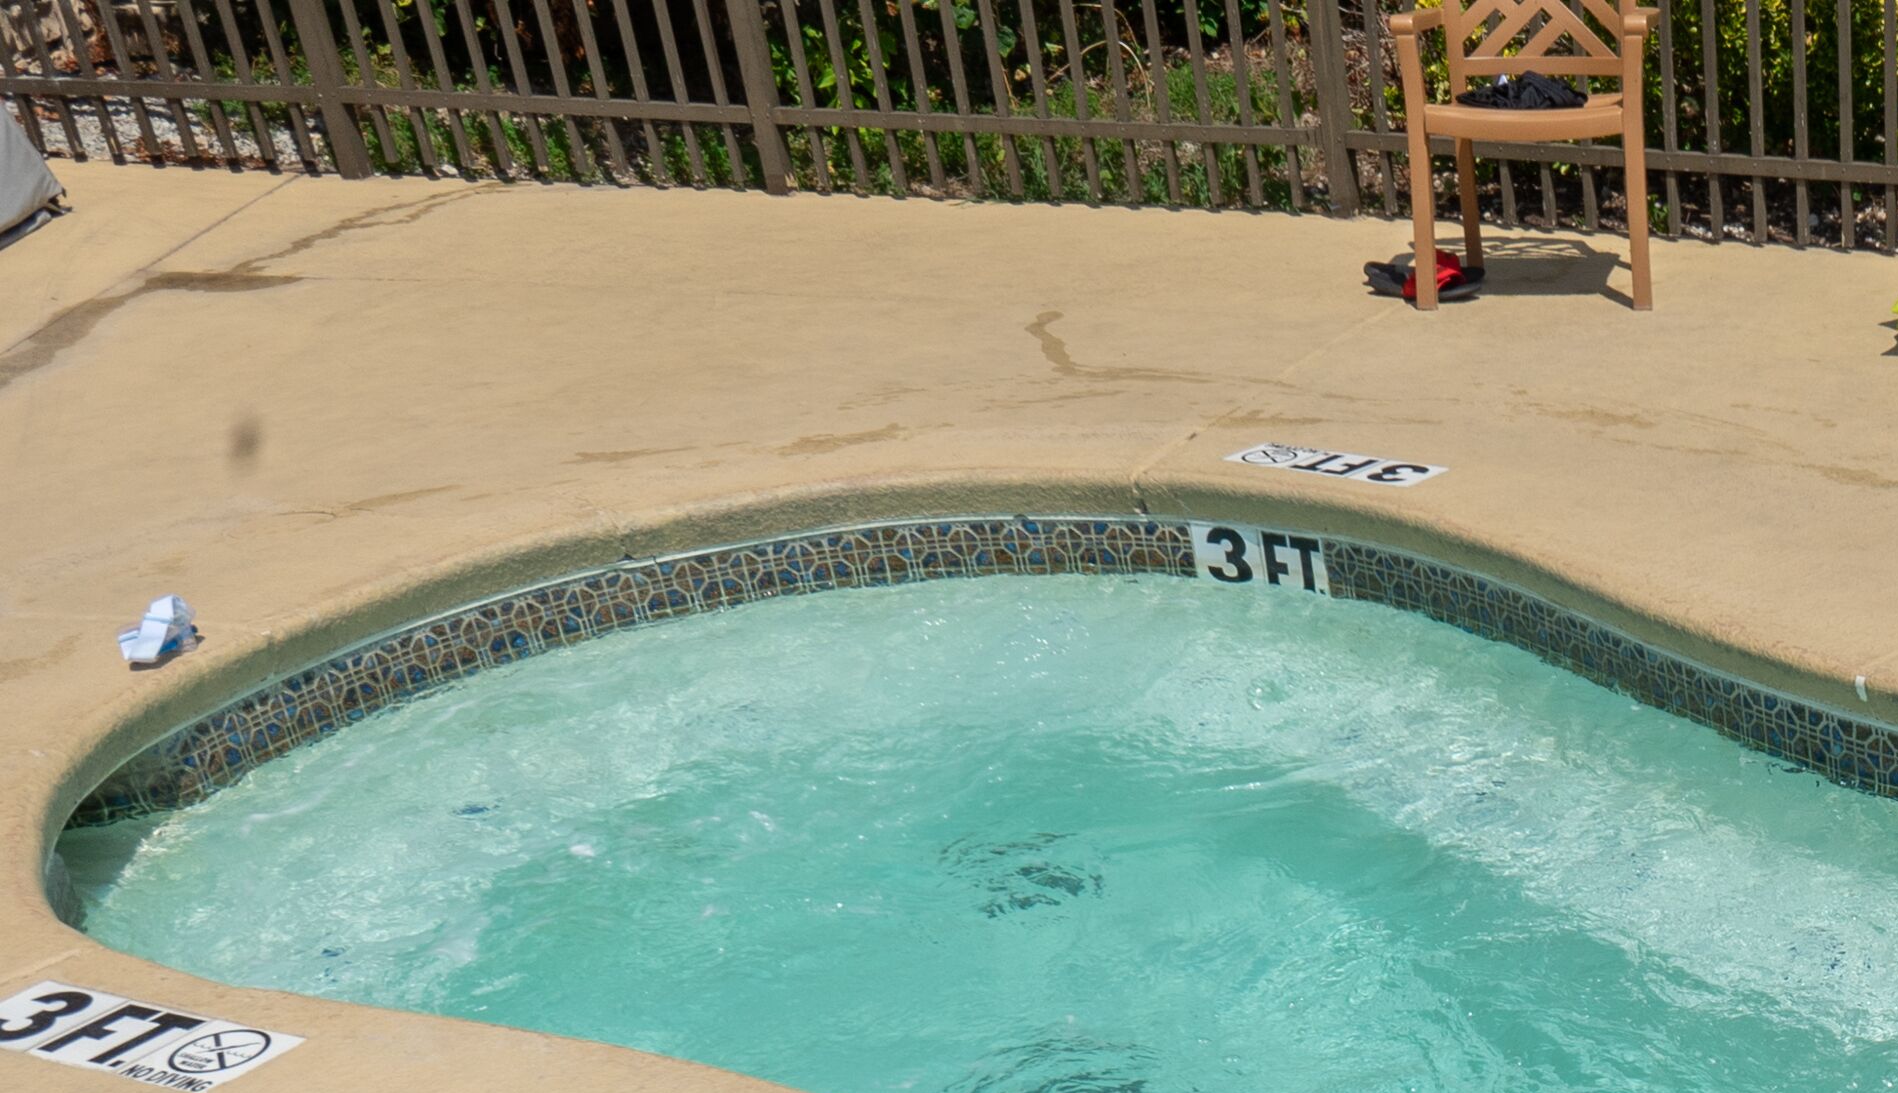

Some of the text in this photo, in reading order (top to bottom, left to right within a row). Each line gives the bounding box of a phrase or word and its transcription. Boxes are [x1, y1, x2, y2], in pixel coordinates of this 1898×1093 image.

[1366, 464, 1430, 482] 3
[1206, 526, 1326, 596] 3 FT.
[0, 991, 208, 1068] 3 FT.
[120, 1064, 213, 1093] NO DIVING
